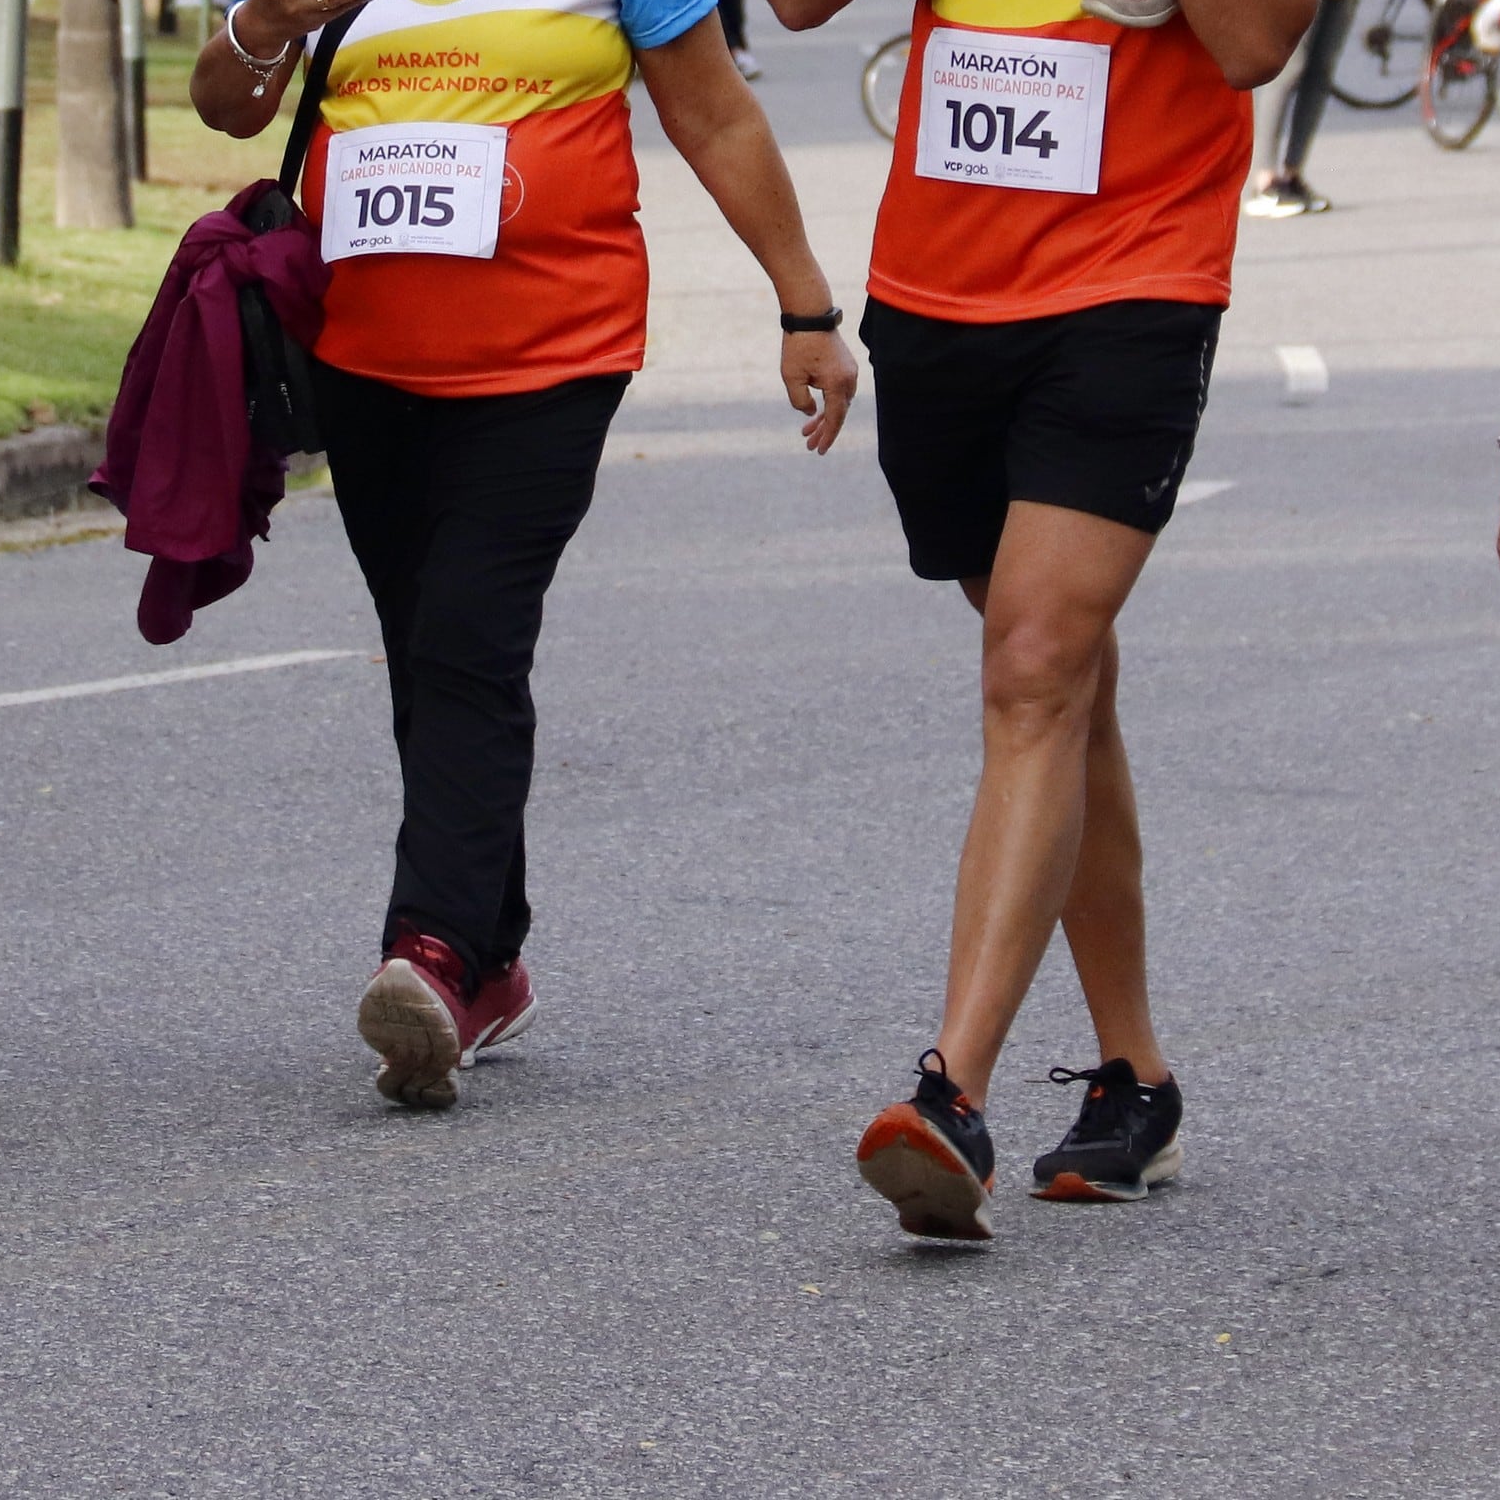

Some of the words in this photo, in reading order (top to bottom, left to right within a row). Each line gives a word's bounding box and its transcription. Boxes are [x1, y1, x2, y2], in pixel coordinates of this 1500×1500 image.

[377, 47, 480, 69] MARATÓN
[950, 50, 1057, 79] MARATÓN
[397, 76, 509, 93] NICANDRO
[515, 78, 554, 95] PAZ
[933, 70, 978, 90] CARLOS
[982, 76, 1052, 98] NICANDRO
[1056, 84, 1085, 101] PAZ
[946, 99, 1059, 159] 1014
[358, 140, 457, 165] MARATÓN
[340, 163, 385, 183] CARLOS
[388, 162, 451, 177] NICANDRO
[456, 164, 482, 179] PAZ
[354, 184, 455, 229] 1015
